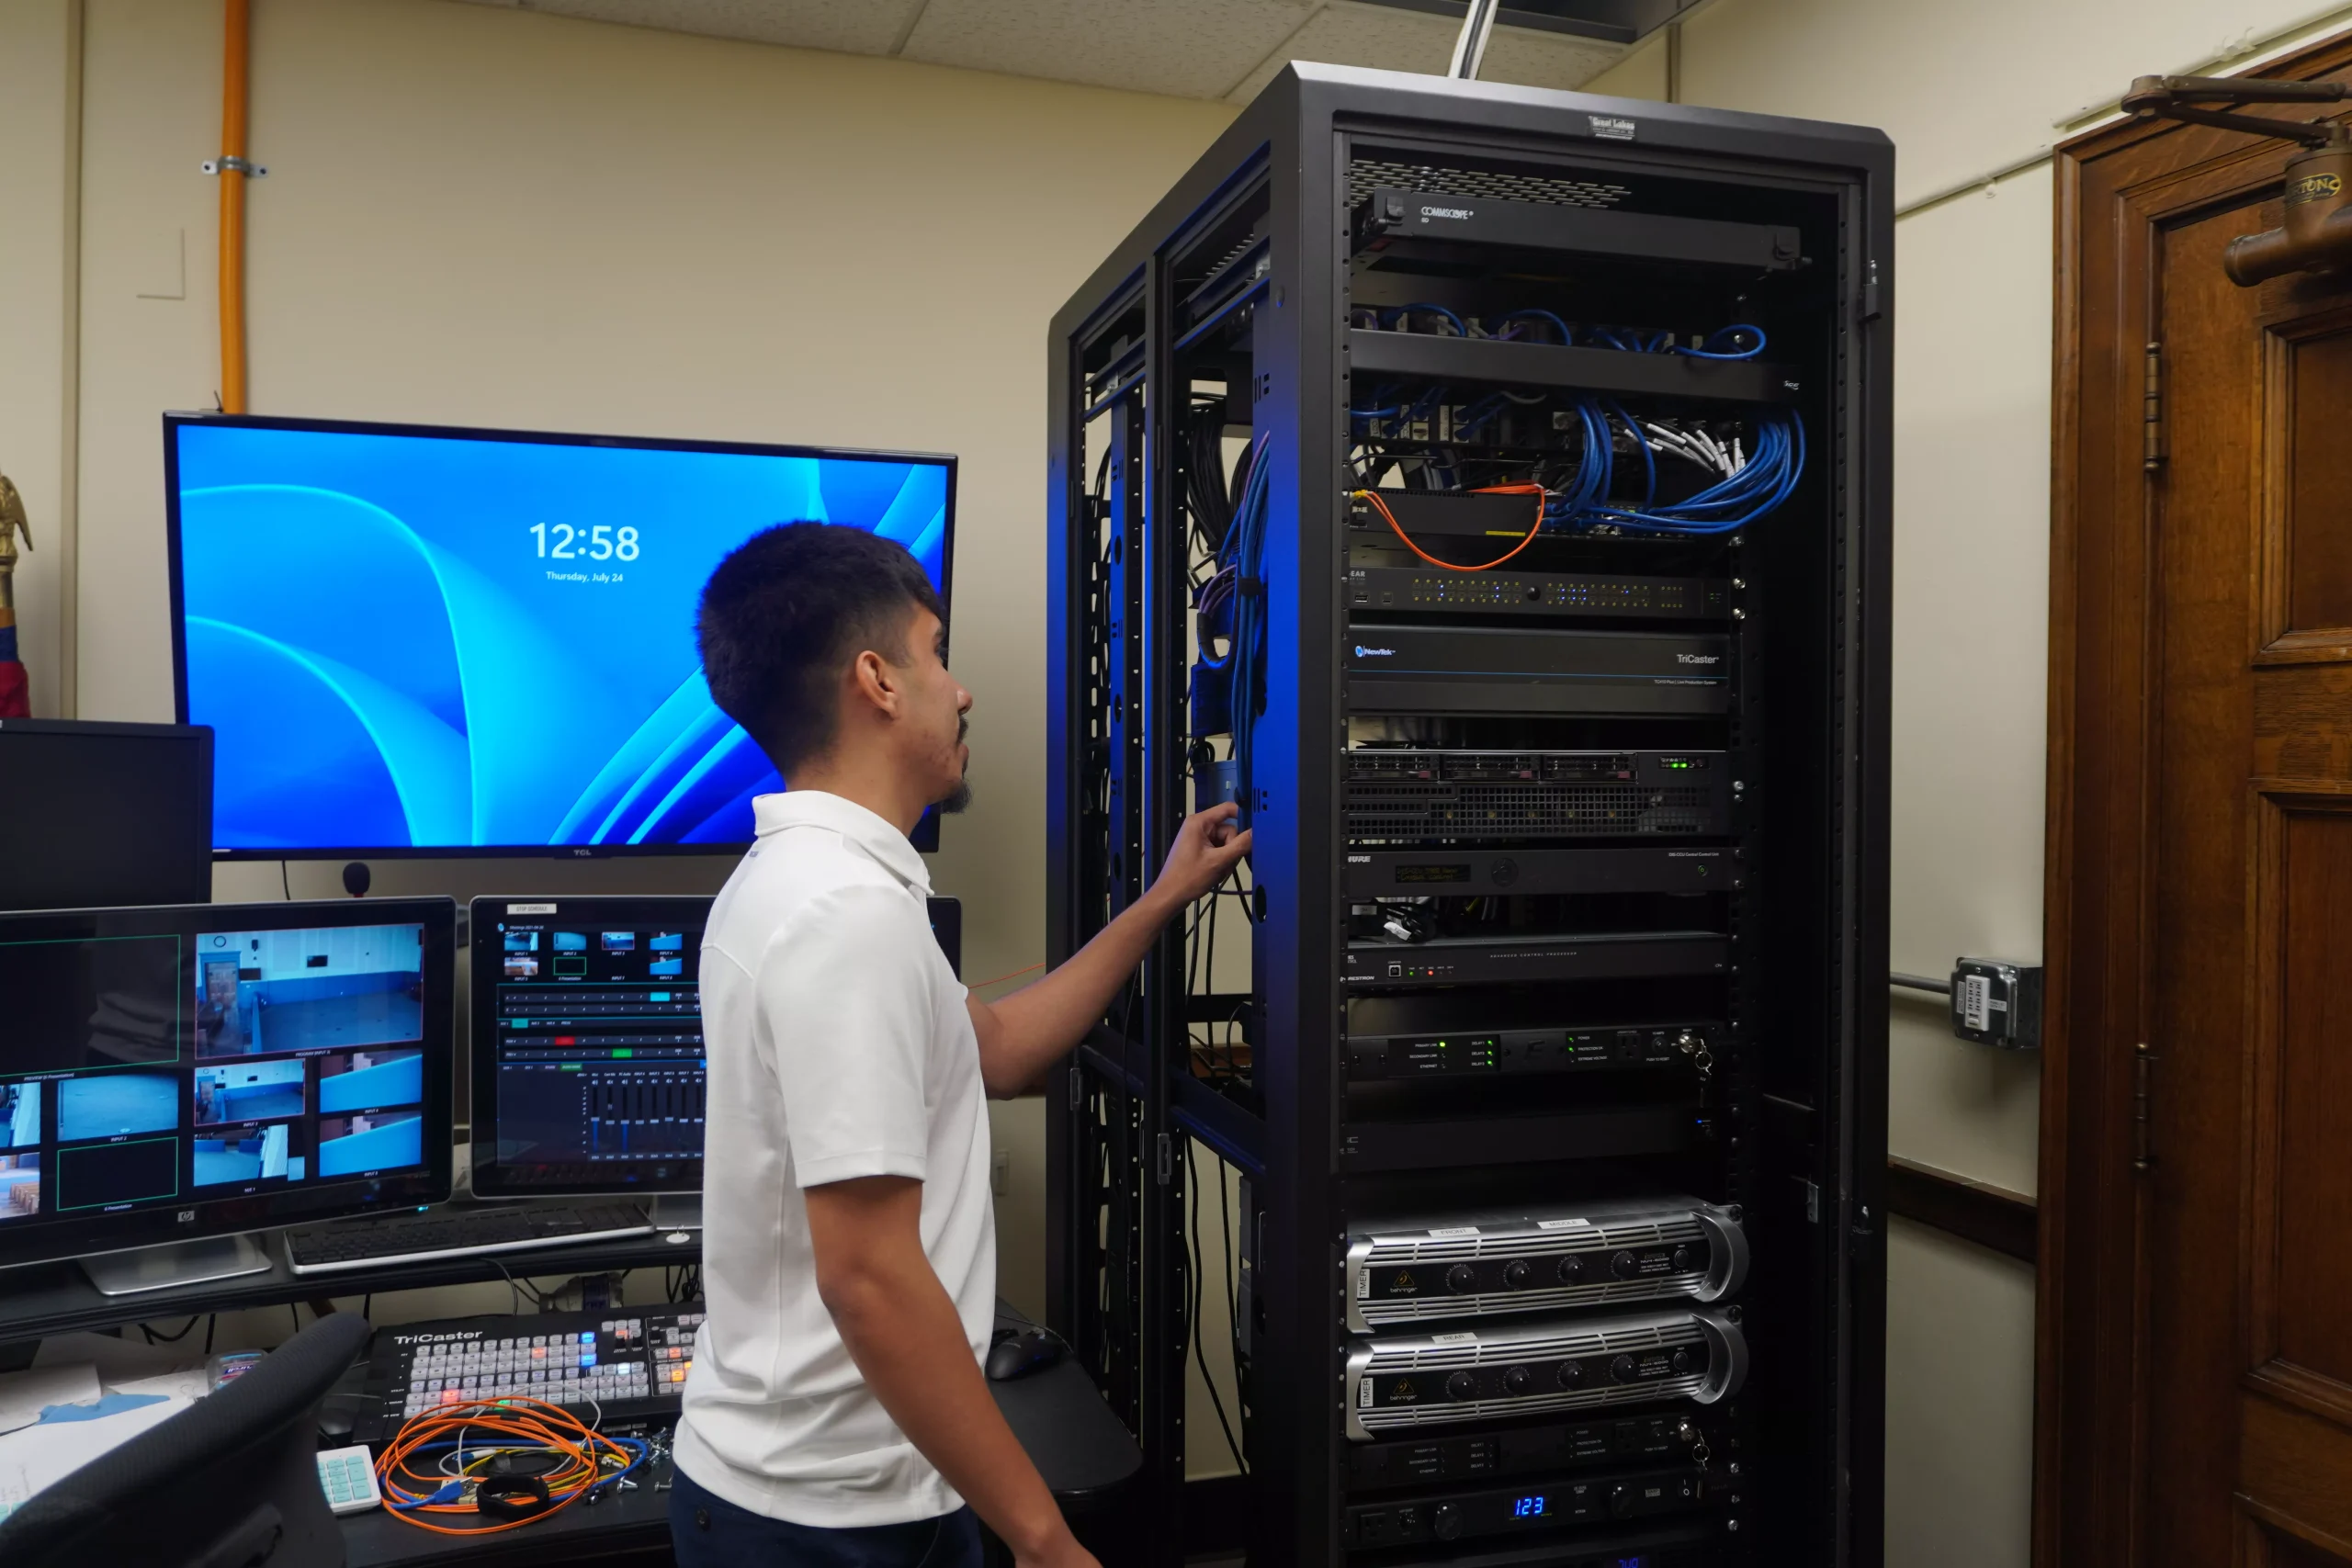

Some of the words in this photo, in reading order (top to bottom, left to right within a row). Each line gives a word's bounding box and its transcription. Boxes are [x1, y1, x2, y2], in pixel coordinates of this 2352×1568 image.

[1592, 117, 1611, 127] Great
[1612, 118, 1635, 130] Lakes
[1420, 206, 1469, 220] COMMSCOPE
[529, 522, 640, 562] 12:58
[546, 570, 590, 583] Thursday,
[591, 572, 610, 583] July
[611, 573, 624, 582] 24
[1677, 654, 1716, 664] TriCaster
[1548, 1219, 1577, 1227] MIDDLE
[1440, 1228, 1467, 1236] FRONT
[1359, 1270, 1367, 1297] TIMER
[393, 1330, 483, 1345] TriCaster
[1442, 1333, 1465, 1341] REAR
[1363, 1379, 1371, 1405] TIMER
[1389, 1394, 1418, 1403] behringer
[1516, 1496, 1544, 1516] 123
